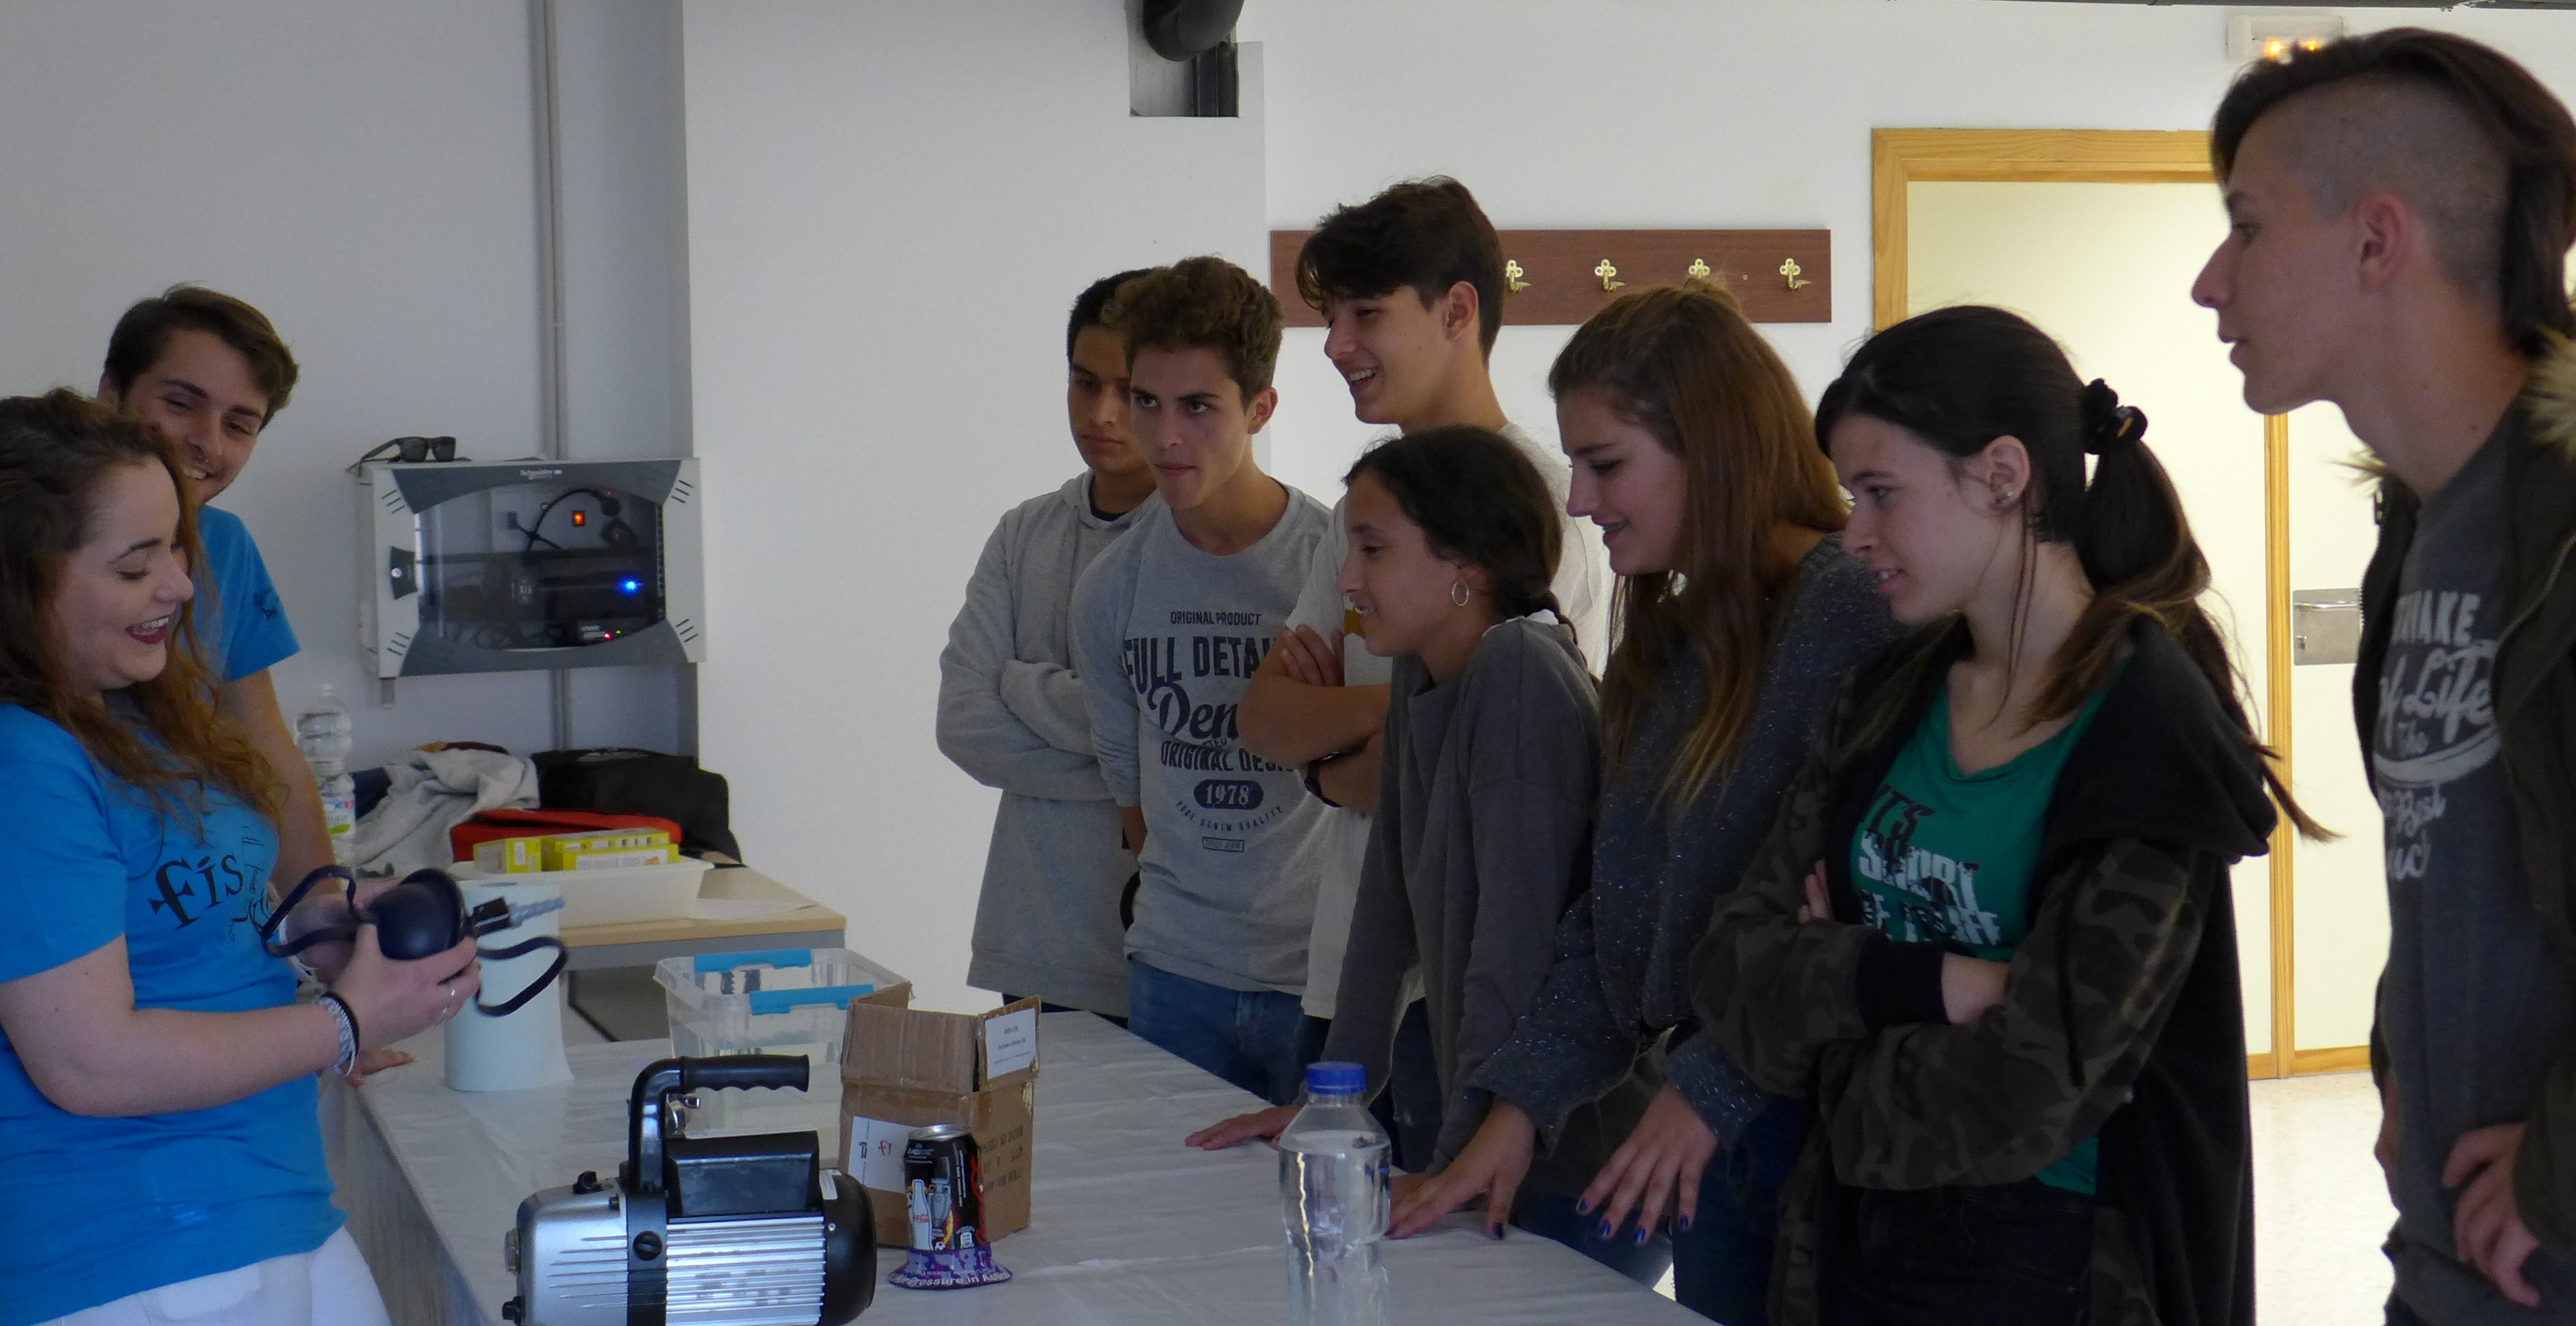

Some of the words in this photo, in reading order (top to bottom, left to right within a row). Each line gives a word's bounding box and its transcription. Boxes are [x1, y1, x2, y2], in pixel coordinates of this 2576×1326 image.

[1170, 611, 1214, 624] ORIGINAL
[1216, 612, 1261, 625] PRODUCT
[1123, 636, 1182, 694] FULL
[1161, 741, 1233, 772] ORIGINAL
[1205, 784, 1250, 805] 1978
[1239, 805, 1283, 831] QUALITY
[967, 1275, 979, 1284] in
